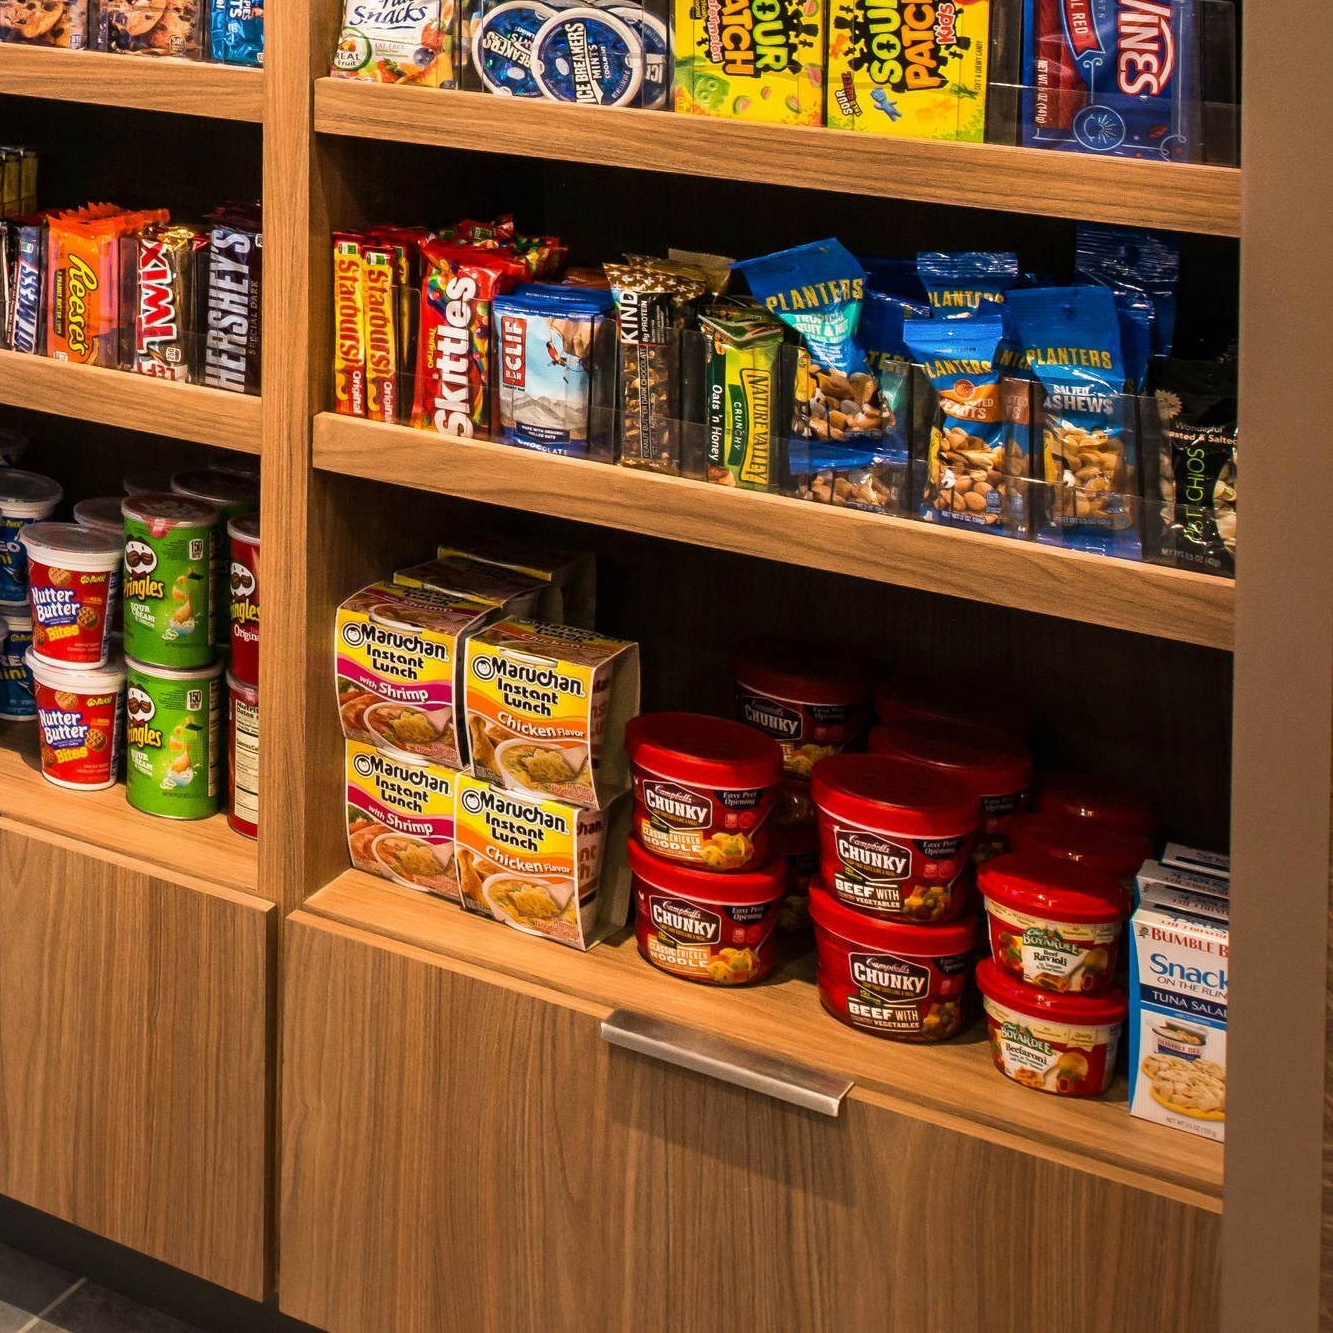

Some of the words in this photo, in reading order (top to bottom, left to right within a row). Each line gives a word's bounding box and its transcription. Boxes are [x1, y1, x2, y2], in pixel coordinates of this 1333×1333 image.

[349, 2, 428, 26] Snacks
[1073, 10, 1086, 36] RED
[592, 43, 603, 80] MINTS
[68, 253, 98, 355] Reese's
[138, 238, 176, 355] TWIX
[765, 278, 864, 313] PLANTERS
[205, 229, 251, 392] HERSHEY'S
[620, 290, 639, 345] KIND
[434, 275, 477, 438] Skittles
[504, 320, 527, 370] CLIF
[32, 587, 74, 606] Nutter
[37, 601, 81, 620] Butter
[48, 624, 80, 641] Bites
[361, 623, 447, 661] Maruchan
[366, 644, 425, 669] Instant
[371, 658, 418, 681] Lunch
[359, 674, 378, 688] with
[378, 681, 429, 704] Shrimp
[491, 654, 582, 696] Maruchan
[497, 678, 558, 705] Instant
[502, 692, 552, 717] Lunch
[38, 709, 82, 729] Nutter
[497, 711, 556, 738] Chicken
[557, 727, 585, 738] Flavor
[44, 724, 88, 744] Butter
[55, 746, 89, 763] Bites
[371, 755, 450, 796] Maruchan
[375, 775, 429, 803] Instant
[380, 788, 423, 813] Lunch
[479, 790, 567, 834] Maruchan
[646, 788, 708, 825] CHUNKY
[368, 804, 386, 820] with
[386, 812, 434, 835] Shrimp
[485, 812, 545, 841] Instant
[491, 827, 539, 853] Lunch
[485, 844, 543, 873] Chicken
[544, 863, 571, 875] Flavor
[838, 838, 908, 877] CHUNKY
[835, 879, 874, 898] BEEF
[876, 887, 900, 901] WITH
[653, 903, 717, 940] CHUNKY
[1033, 952, 1068, 967] Ravioli
[853, 961, 926, 992] CHUNKY
[1157, 976, 1172, 986] ON
[1175, 980, 1197, 992] THE
[1201, 985, 1227, 998] RUN
[848, 1002, 893, 1021] BEEF
[895, 1009, 919, 1021] WITH
